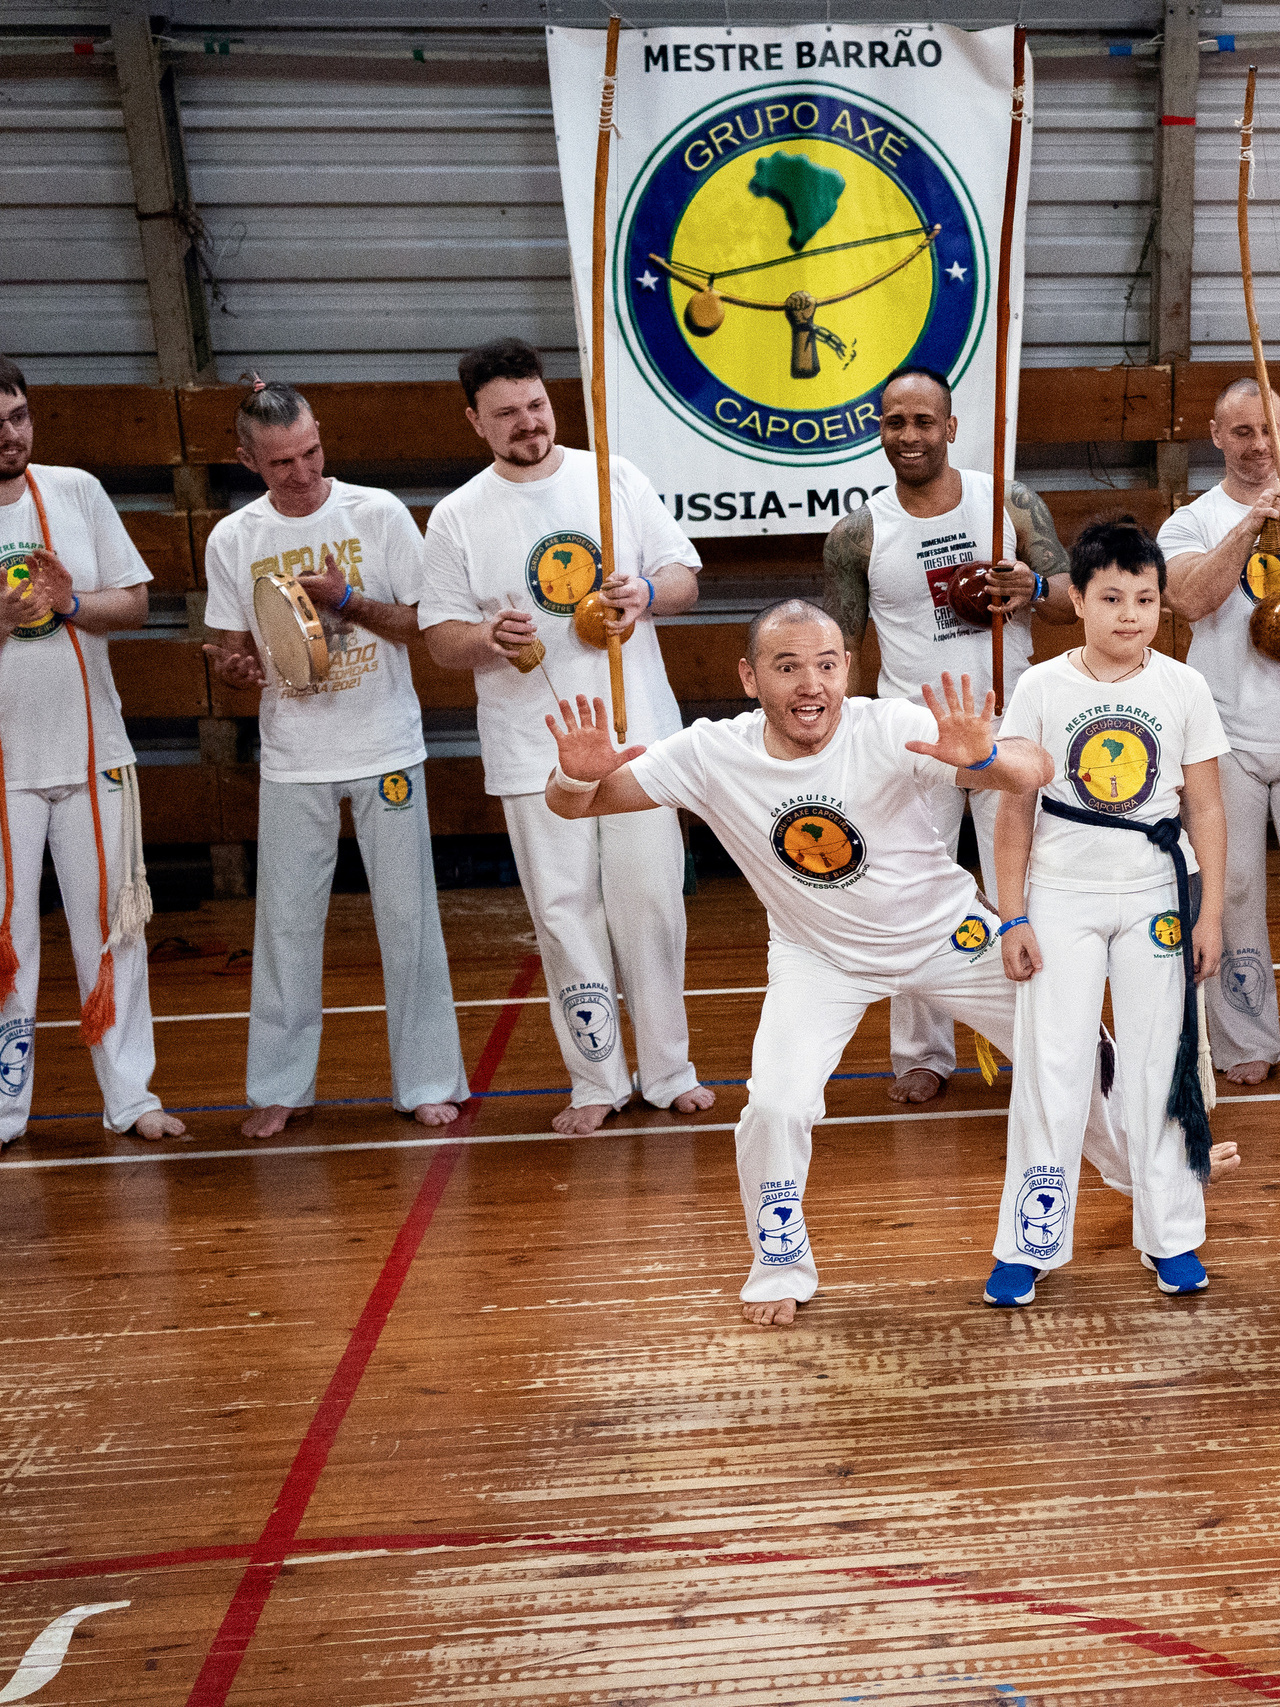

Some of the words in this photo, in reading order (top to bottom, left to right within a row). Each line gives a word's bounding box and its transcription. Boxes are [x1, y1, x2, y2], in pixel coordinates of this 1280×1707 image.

[643, 43, 783, 72] MESTRE
[797, 28, 943, 68] BARRÃO
[684, 101, 820, 174] GRUPO
[715, 398, 882, 444] CAPOEIR
[659, 485, 890, 522] USSIA-MO
[530, 546, 545, 572] GRUPO
[560, 535, 598, 555] CAPOEIRA
[916, 546, 949, 560] PROFESSOR
[923, 554, 957, 571] MESTRE
[1065, 704, 1111, 734] MESTRE
[1116, 704, 1163, 732] BARRÃO
[1085, 720, 1122, 737] GRUPO
[1088, 798, 1138, 813] CAPOEIRA
[812, 808, 849, 833] CAPOEIRA
[763, 1249, 803, 1263] CAPOEIRA
[1024, 1242, 1060, 1257] CAPOEIRA
